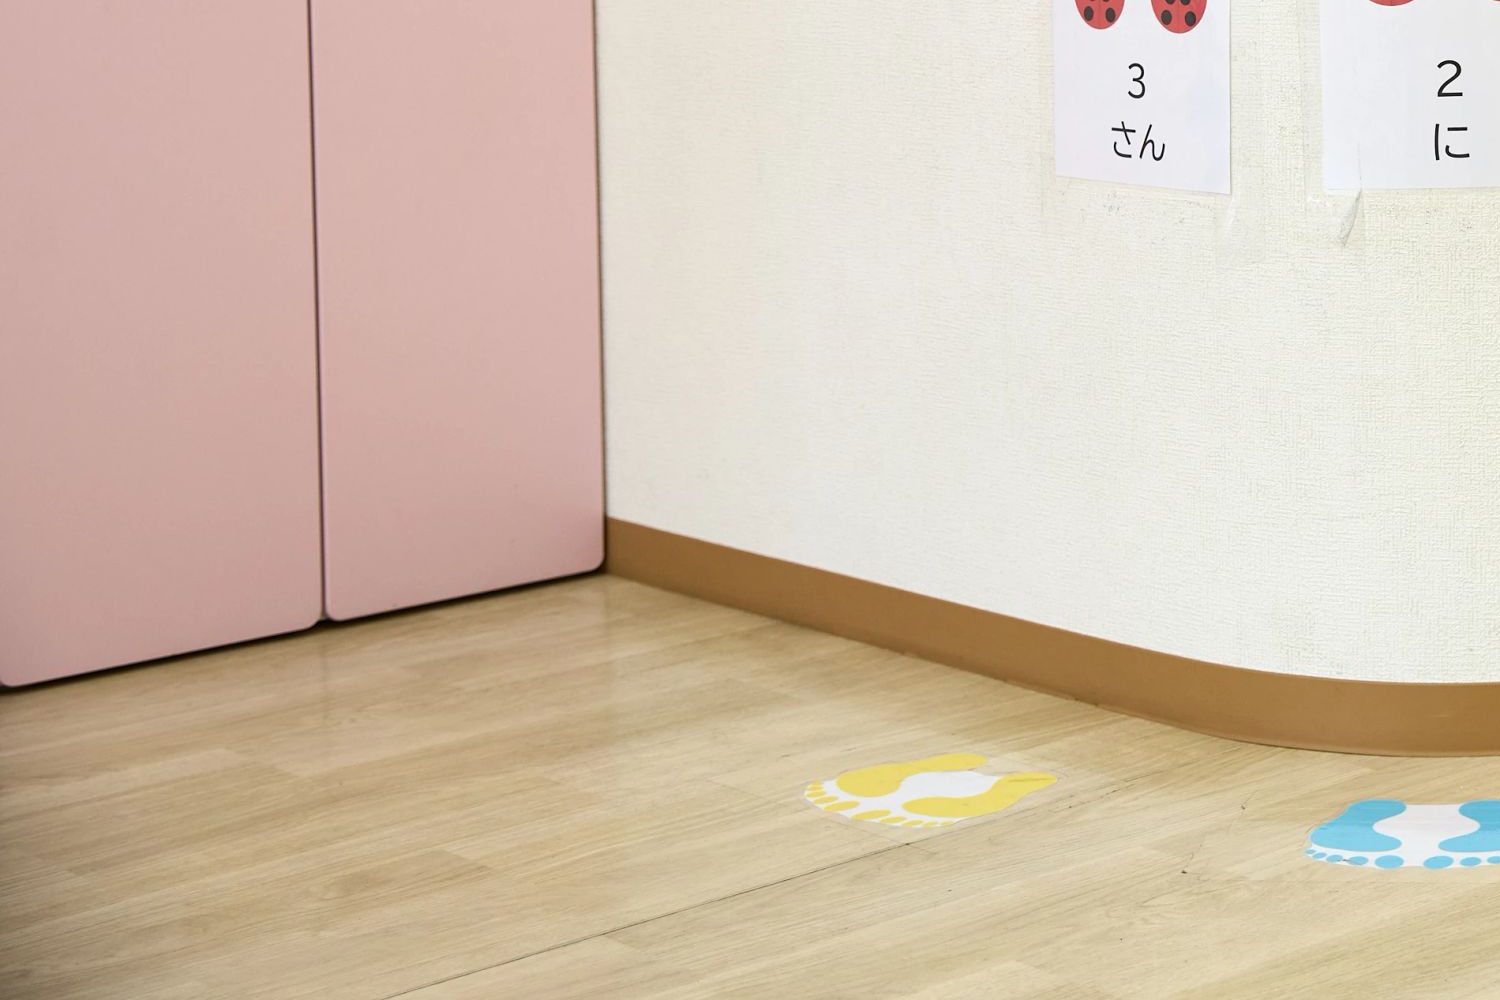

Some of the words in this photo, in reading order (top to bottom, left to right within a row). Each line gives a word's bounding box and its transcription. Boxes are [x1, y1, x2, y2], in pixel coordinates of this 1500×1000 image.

[1128, 63, 1146, 99] 3
[1437, 59, 1463, 97] 2
[1111, 121, 1165, 161] さん
[1434, 122, 1470, 161] に
